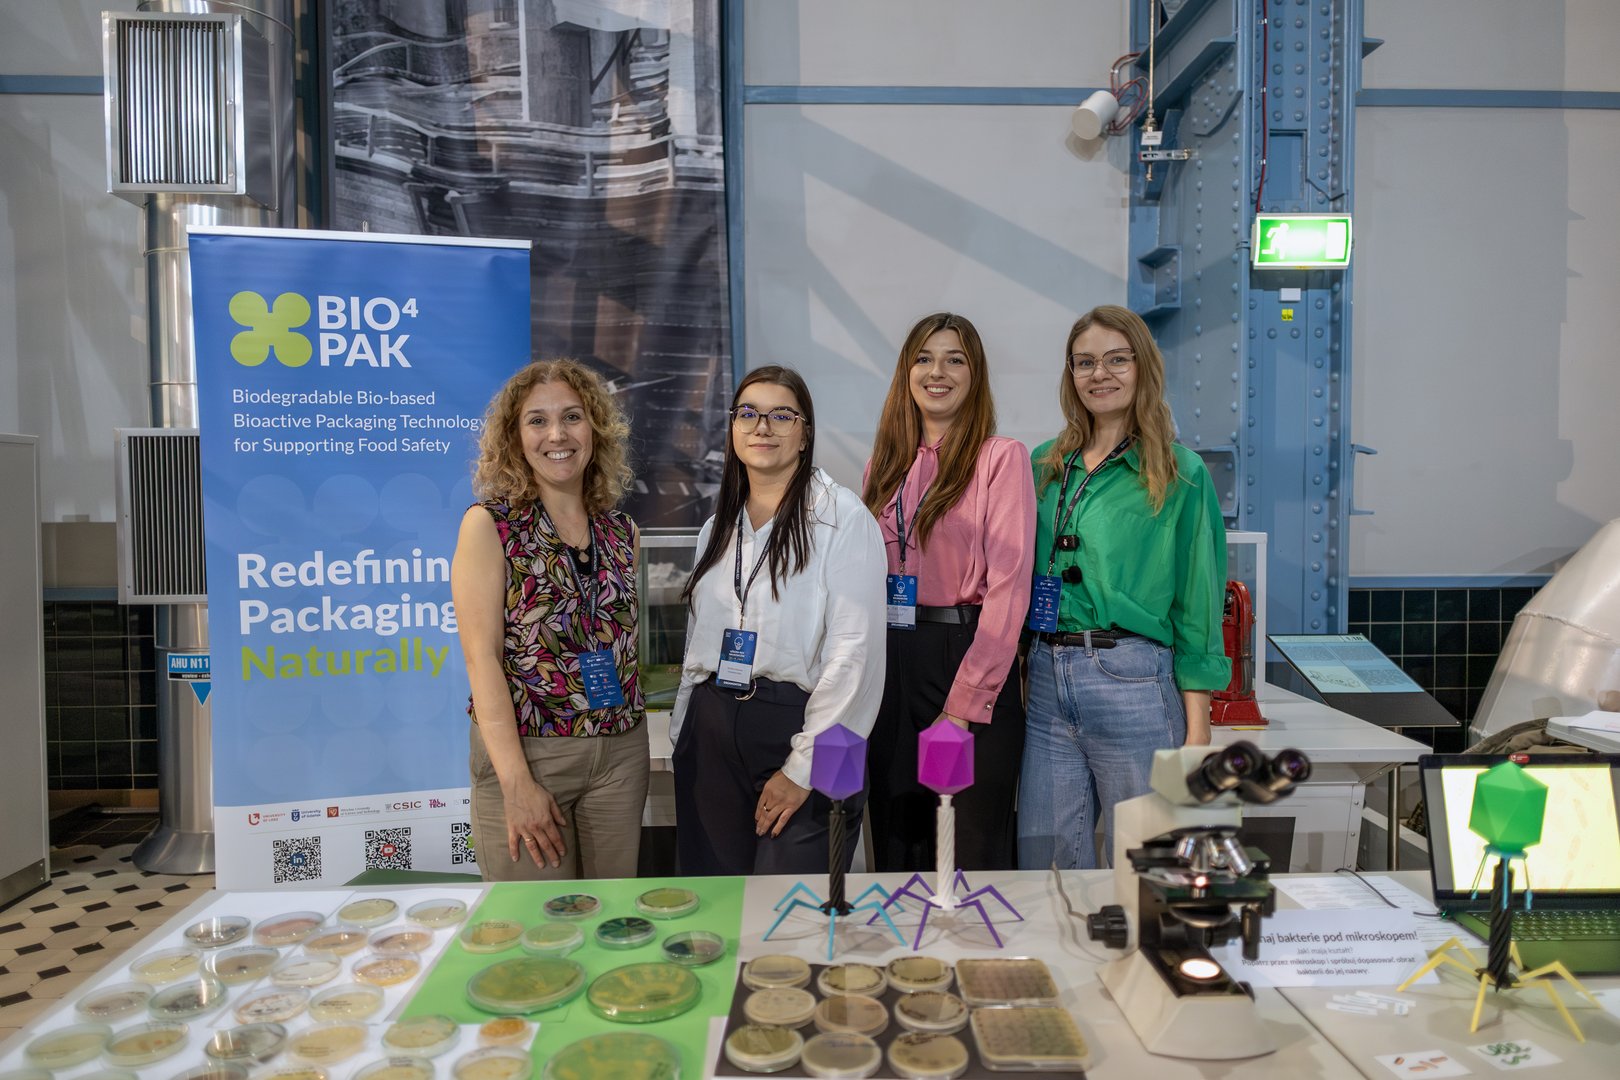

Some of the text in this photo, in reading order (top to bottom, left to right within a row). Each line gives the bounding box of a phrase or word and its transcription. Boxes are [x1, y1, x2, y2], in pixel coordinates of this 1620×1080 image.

[319, 332, 412, 368] PAK
[233, 389, 436, 407] Biodegradable Bio-based
[233, 413, 487, 434] Bioactive Packaging Technology
[234, 438, 451, 456] for Supporting Food Safety
[239, 593, 459, 637] Packaging
[171, 657, 188, 669] AHU
[241, 637, 449, 681] Naturally
[393, 801, 422, 810] CSIC
[1277, 932, 1320, 943] bakterie
[1323, 932, 1343, 943] pod
[1345, 931, 1418, 942] mikroskopem!
